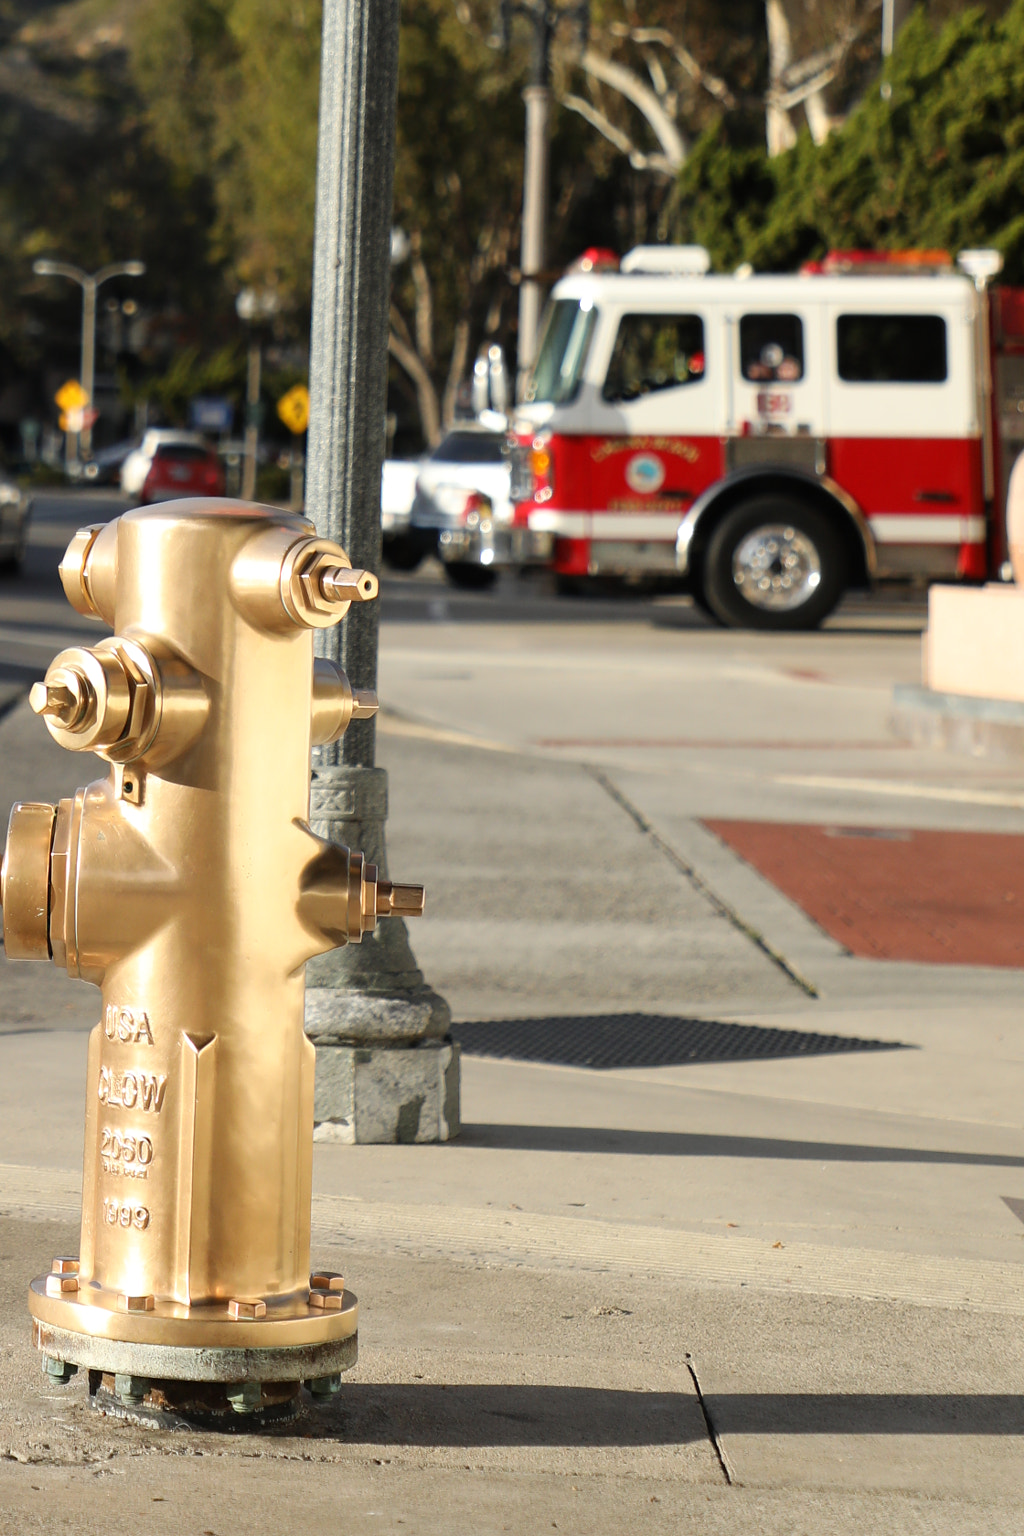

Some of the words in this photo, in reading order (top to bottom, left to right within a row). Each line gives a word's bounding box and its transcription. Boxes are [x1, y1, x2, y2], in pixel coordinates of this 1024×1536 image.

[104, 1004, 154, 1046] USA
[97, 1065, 167, 1114] CLOW
[100, 1127, 153, 1166] 2060
